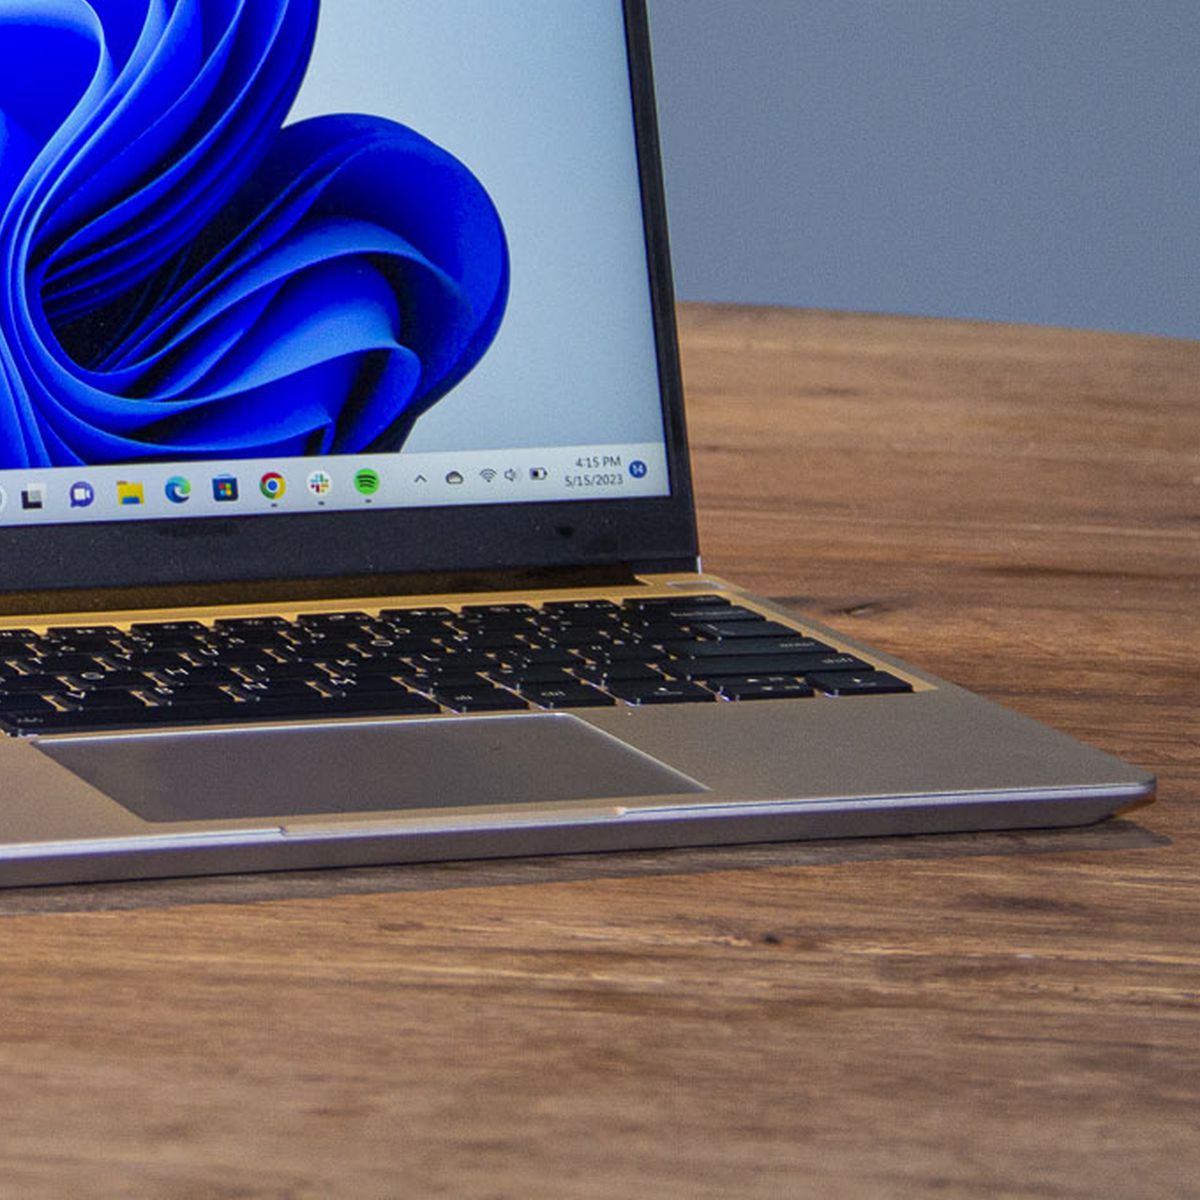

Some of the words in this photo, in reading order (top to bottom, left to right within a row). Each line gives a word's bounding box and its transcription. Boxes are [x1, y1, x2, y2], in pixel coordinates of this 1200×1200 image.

[576, 456, 599, 468] 4:15
[602, 455, 622, 467] PM
[564, 473, 623, 488] 5/15/2023
